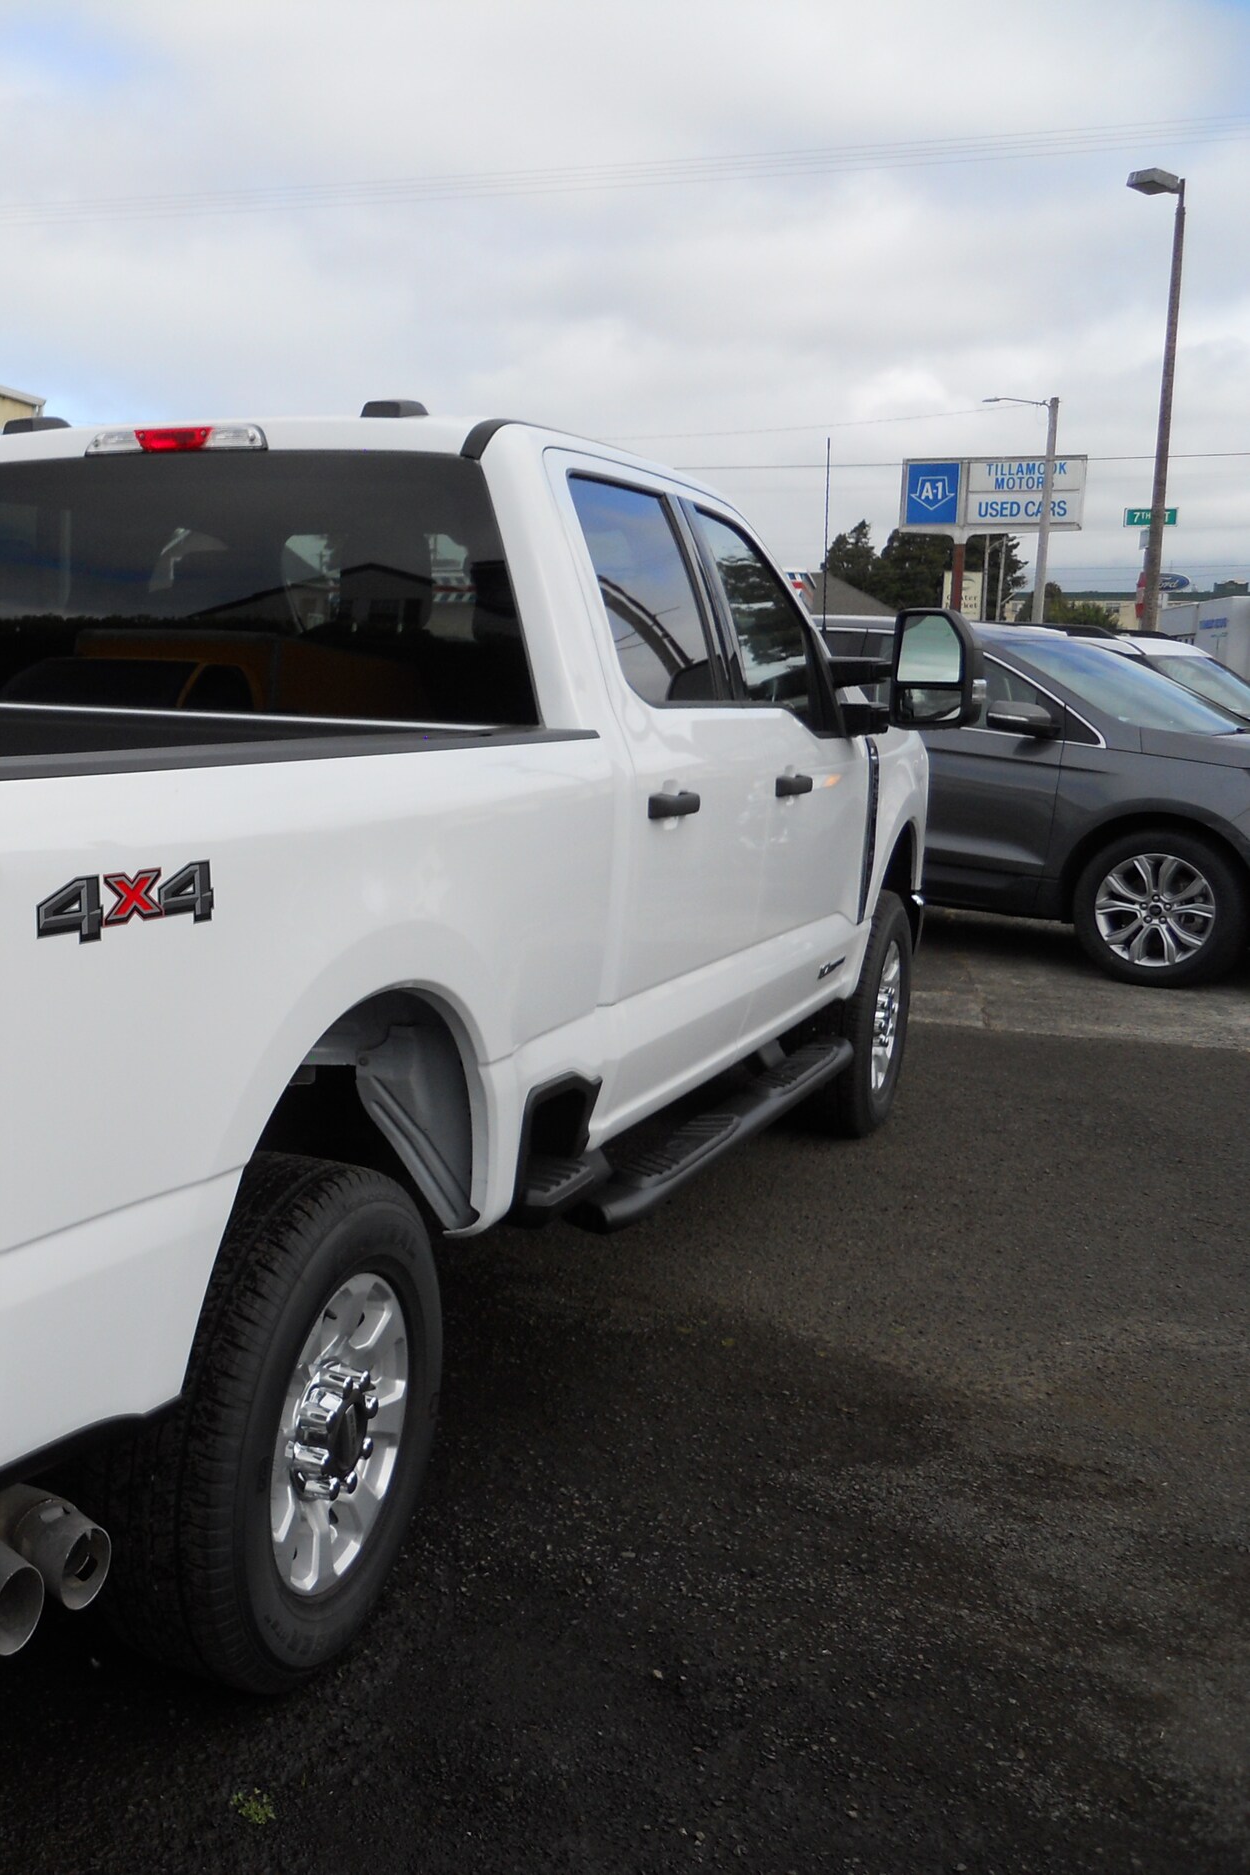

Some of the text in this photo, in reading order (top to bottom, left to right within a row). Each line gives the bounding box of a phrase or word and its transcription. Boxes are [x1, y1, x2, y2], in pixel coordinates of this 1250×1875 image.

[986, 461, 1067, 476] TILLAMOK
[921, 481, 943, 500] A-1
[994, 476, 1054, 490] MOTOR
[978, 501, 1021, 518] USED
[1133, 511, 1151, 523] 7TH
